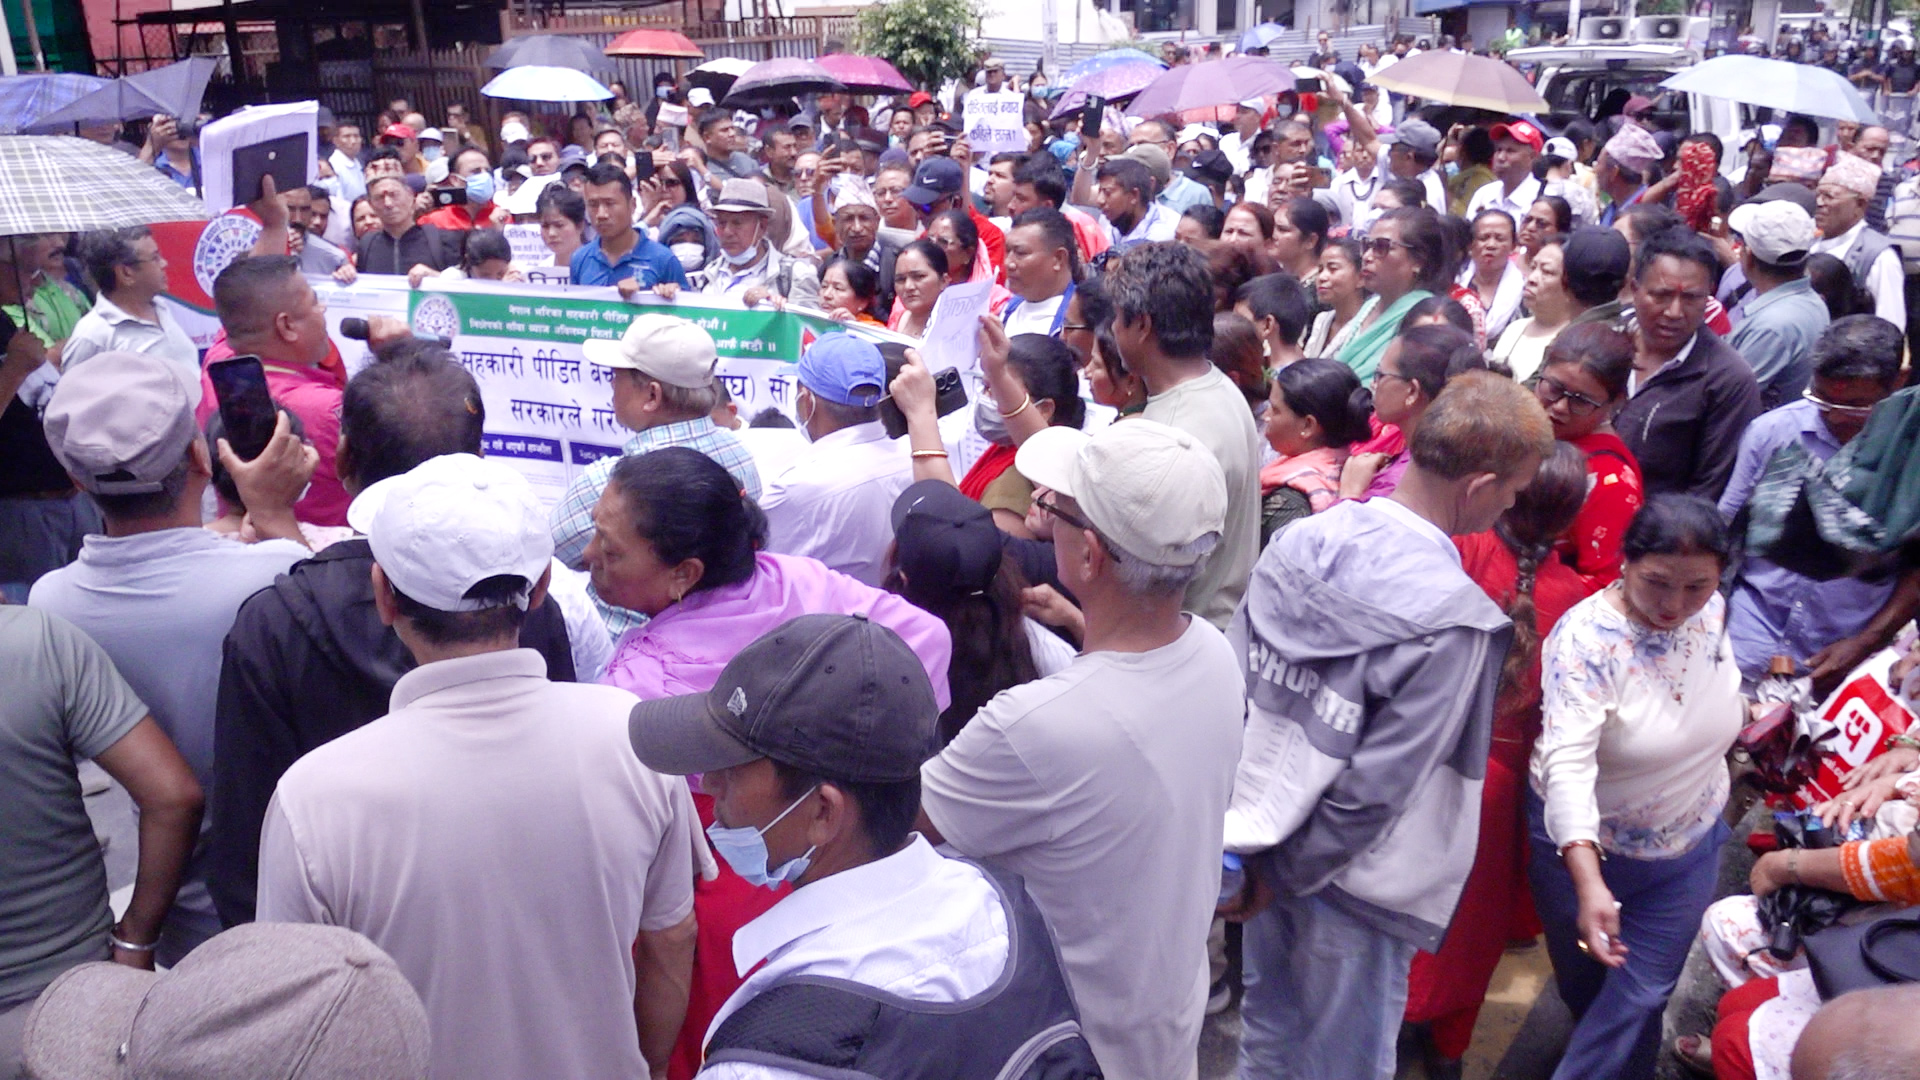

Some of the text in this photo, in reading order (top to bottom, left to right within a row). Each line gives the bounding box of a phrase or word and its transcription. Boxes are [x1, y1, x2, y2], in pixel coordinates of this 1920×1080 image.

[461, 346, 616, 385] सहकारी पीडित बच
[510, 399, 582, 428] सरकारले
